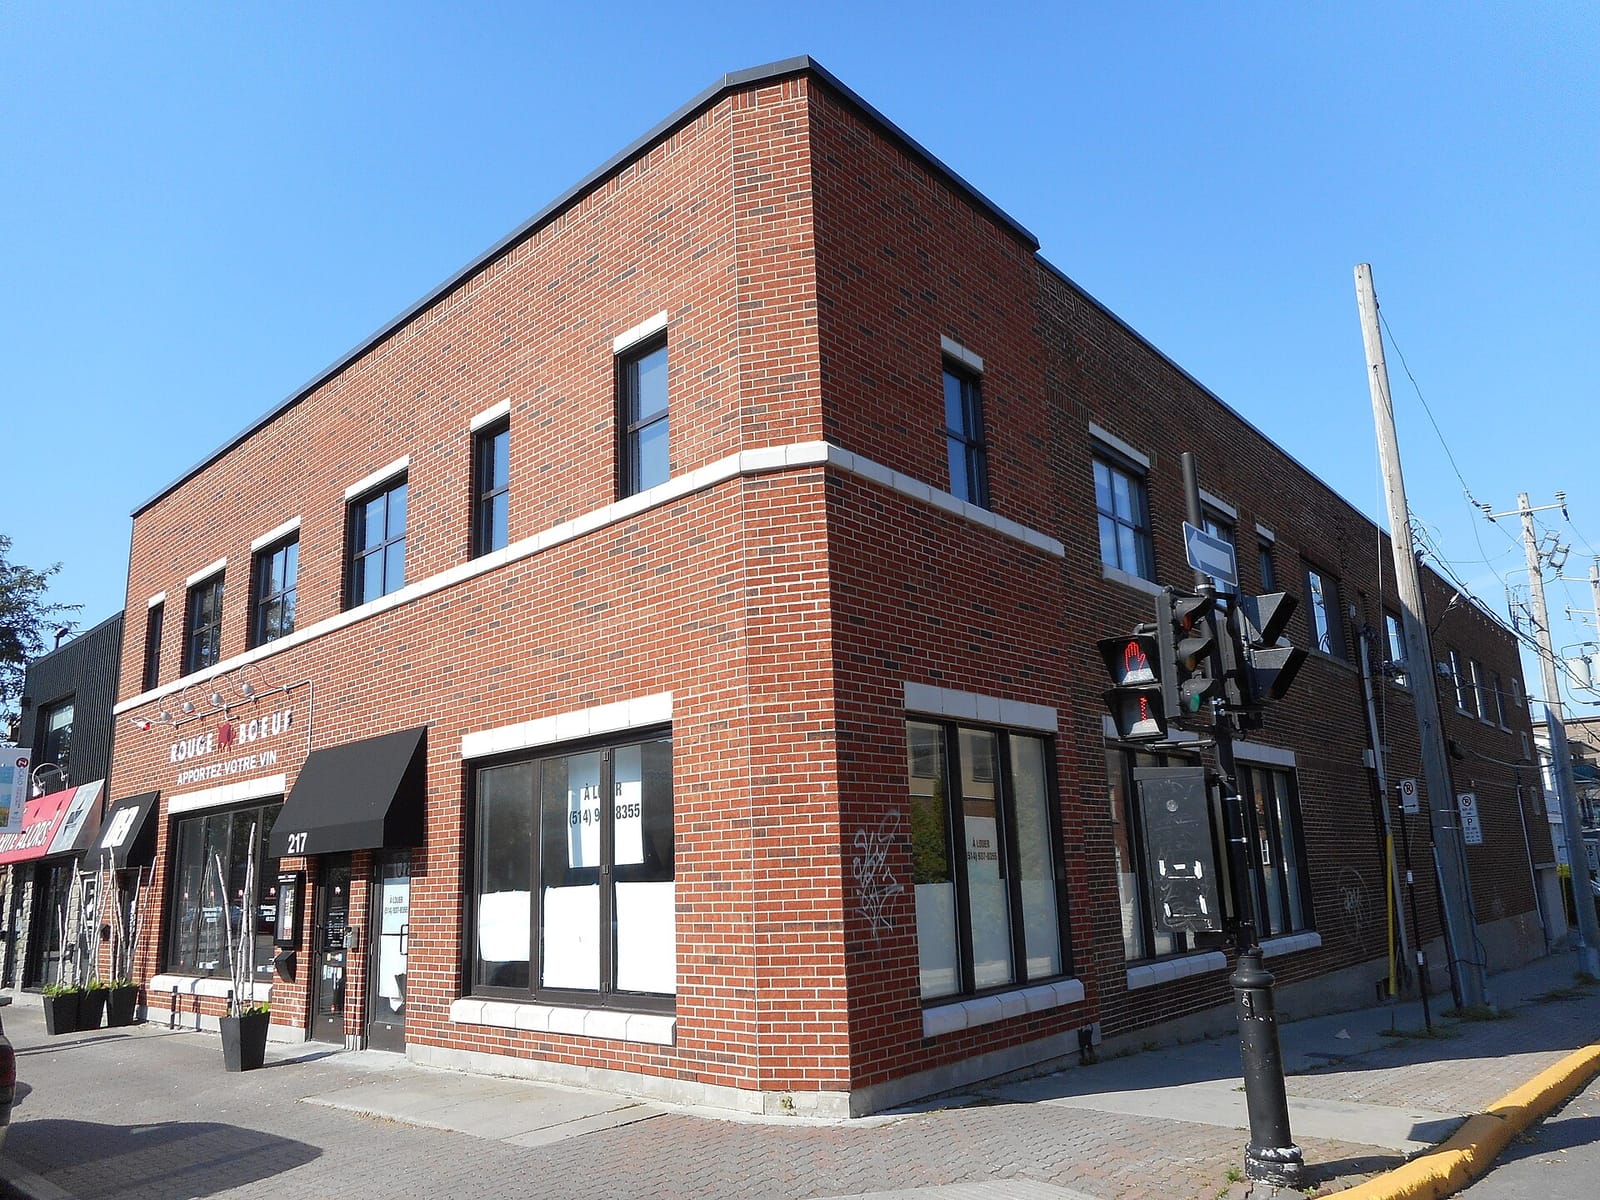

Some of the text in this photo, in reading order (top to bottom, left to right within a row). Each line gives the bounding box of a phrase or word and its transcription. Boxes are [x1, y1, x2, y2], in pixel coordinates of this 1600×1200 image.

[170, 709, 292, 762] ROUGE BOEUF
[176, 749, 277, 786] APPORTEZ VOTRE VIN
[569, 808, 592, 828] (514)
[287, 832, 308, 854] 217
